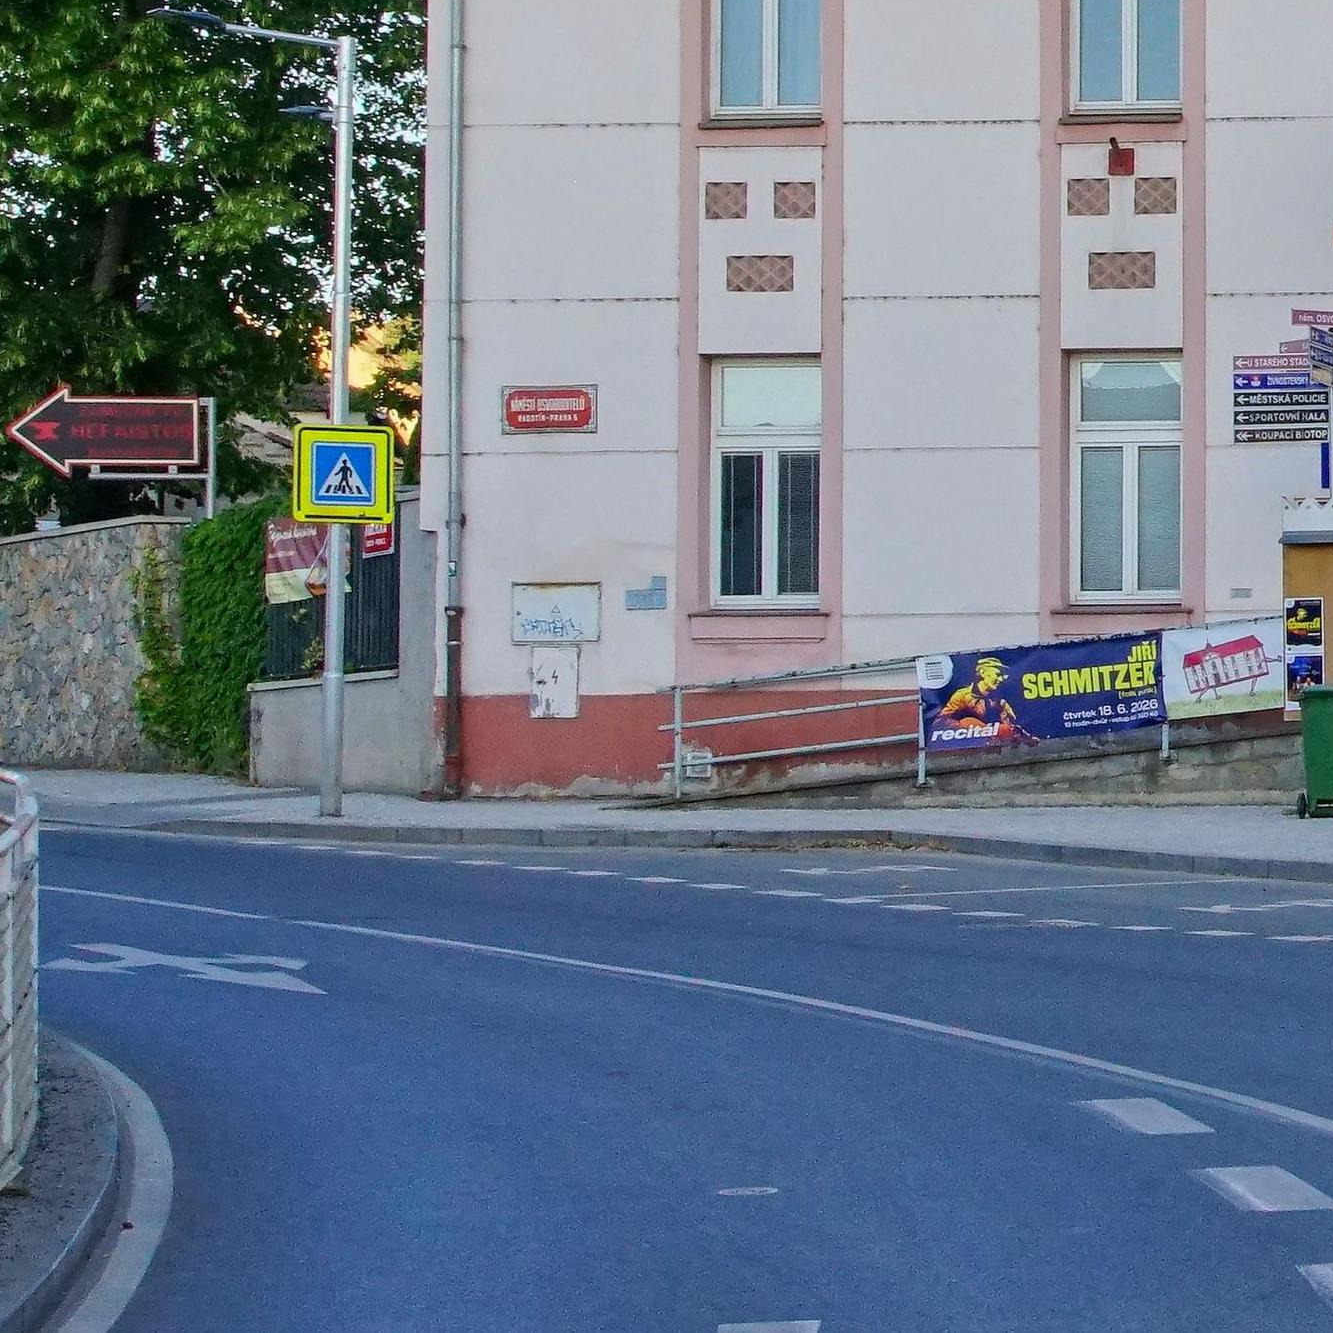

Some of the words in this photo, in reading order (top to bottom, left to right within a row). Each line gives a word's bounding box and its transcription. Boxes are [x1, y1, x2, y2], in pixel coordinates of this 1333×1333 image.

[1247, 358, 1253, 367] U
[1249, 393, 1291, 404] MĚSTSKÁ
[1292, 394, 1327, 403] POLICIE
[1249, 411, 1300, 422] SPORTOVNÍ
[1301, 412, 1327, 421] HALA
[1127, 639, 1157, 662] JIŘÍ
[1021, 660, 1157, 700] SCHMITZER
[1063, 709, 1097, 721] čtvrtek
[1098, 704, 1115, 717] 18.
[1116, 703, 1129, 714] 6.
[930, 722, 1000, 742] recitál
